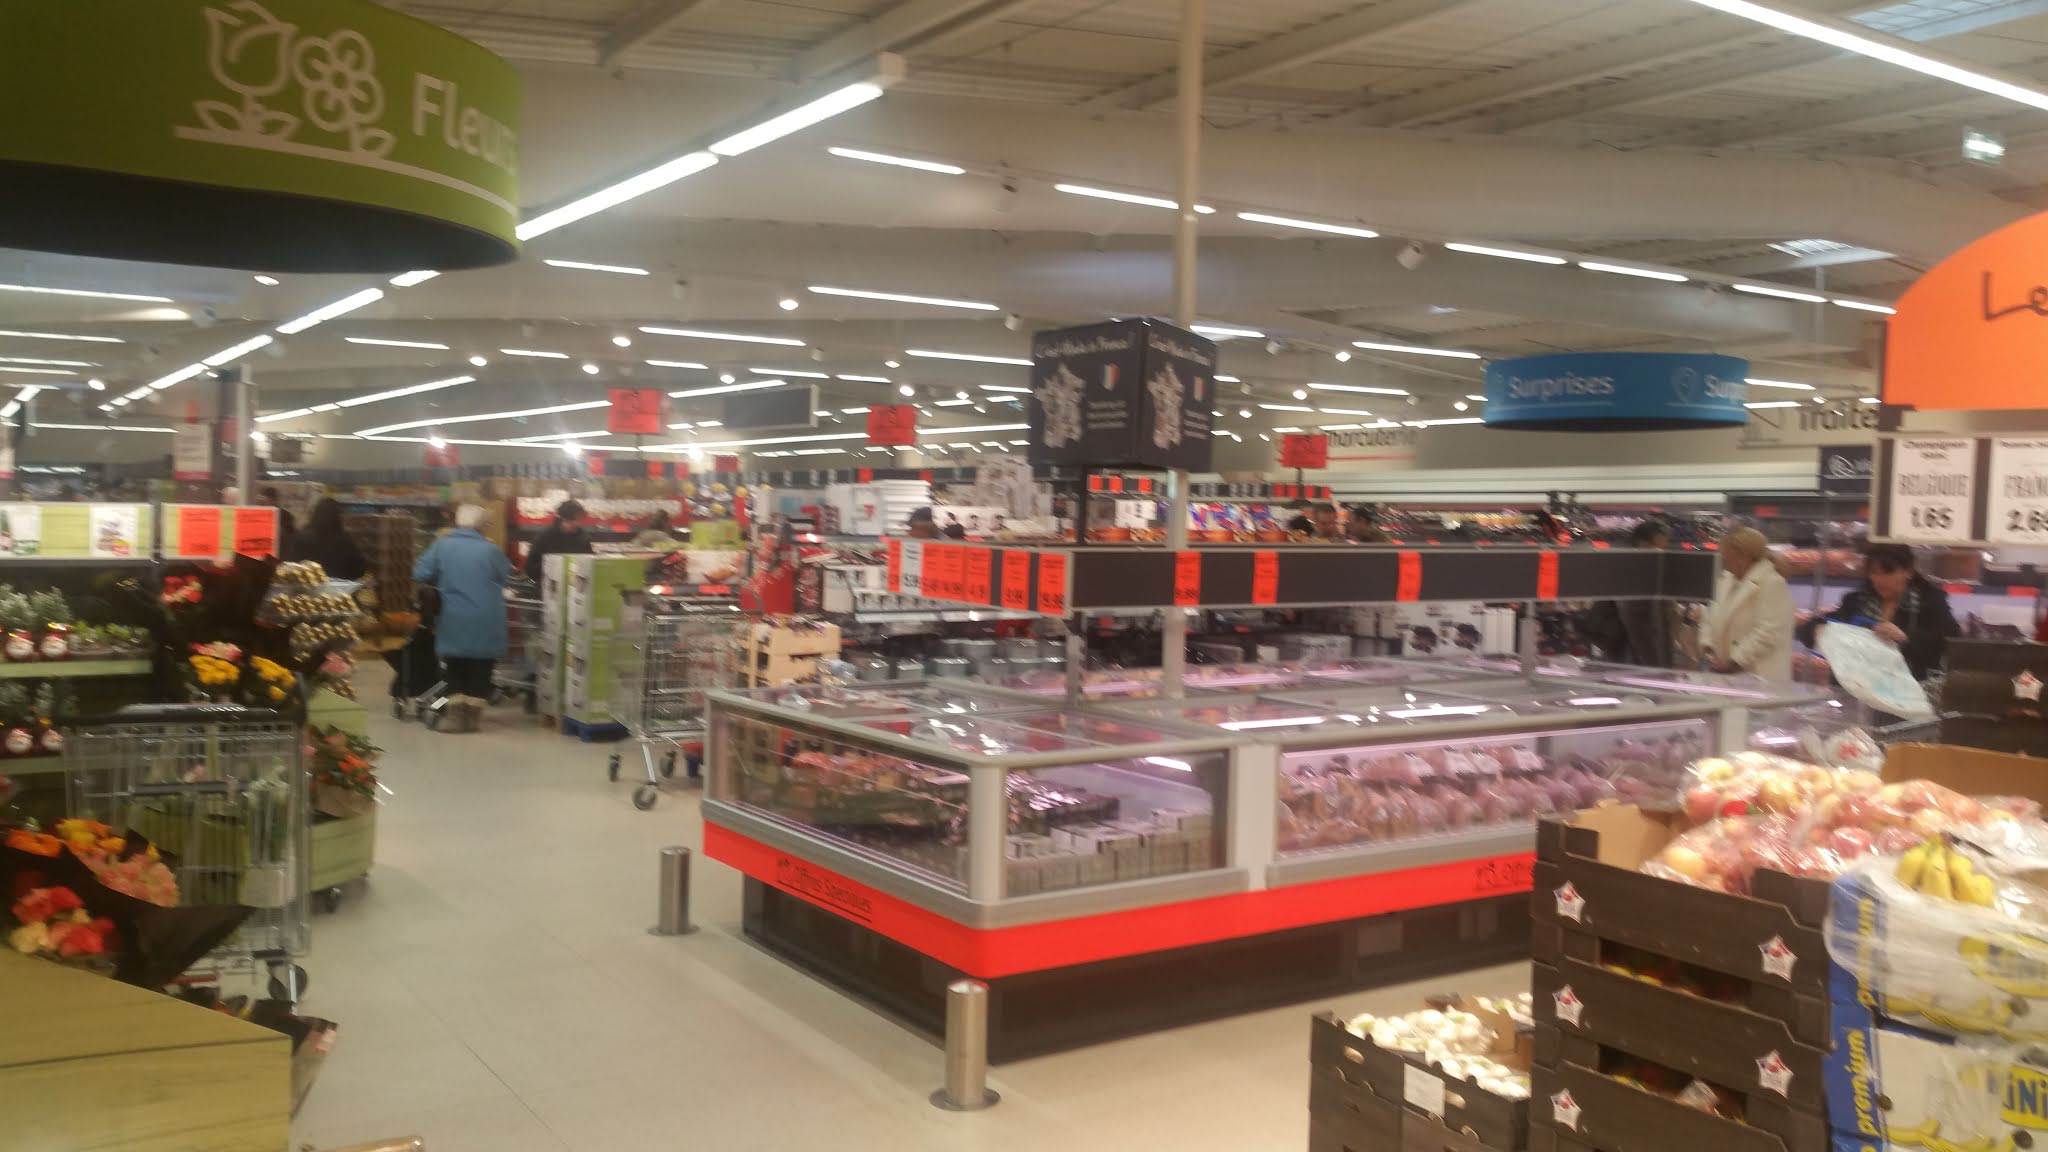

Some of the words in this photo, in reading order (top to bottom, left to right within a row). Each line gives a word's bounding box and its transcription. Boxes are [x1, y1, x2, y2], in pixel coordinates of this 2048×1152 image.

[1509, 370, 1615, 401] Surprises
[1898, 473, 1969, 498] BELGIQUE
[1844, 1028, 1880, 1138] premium
